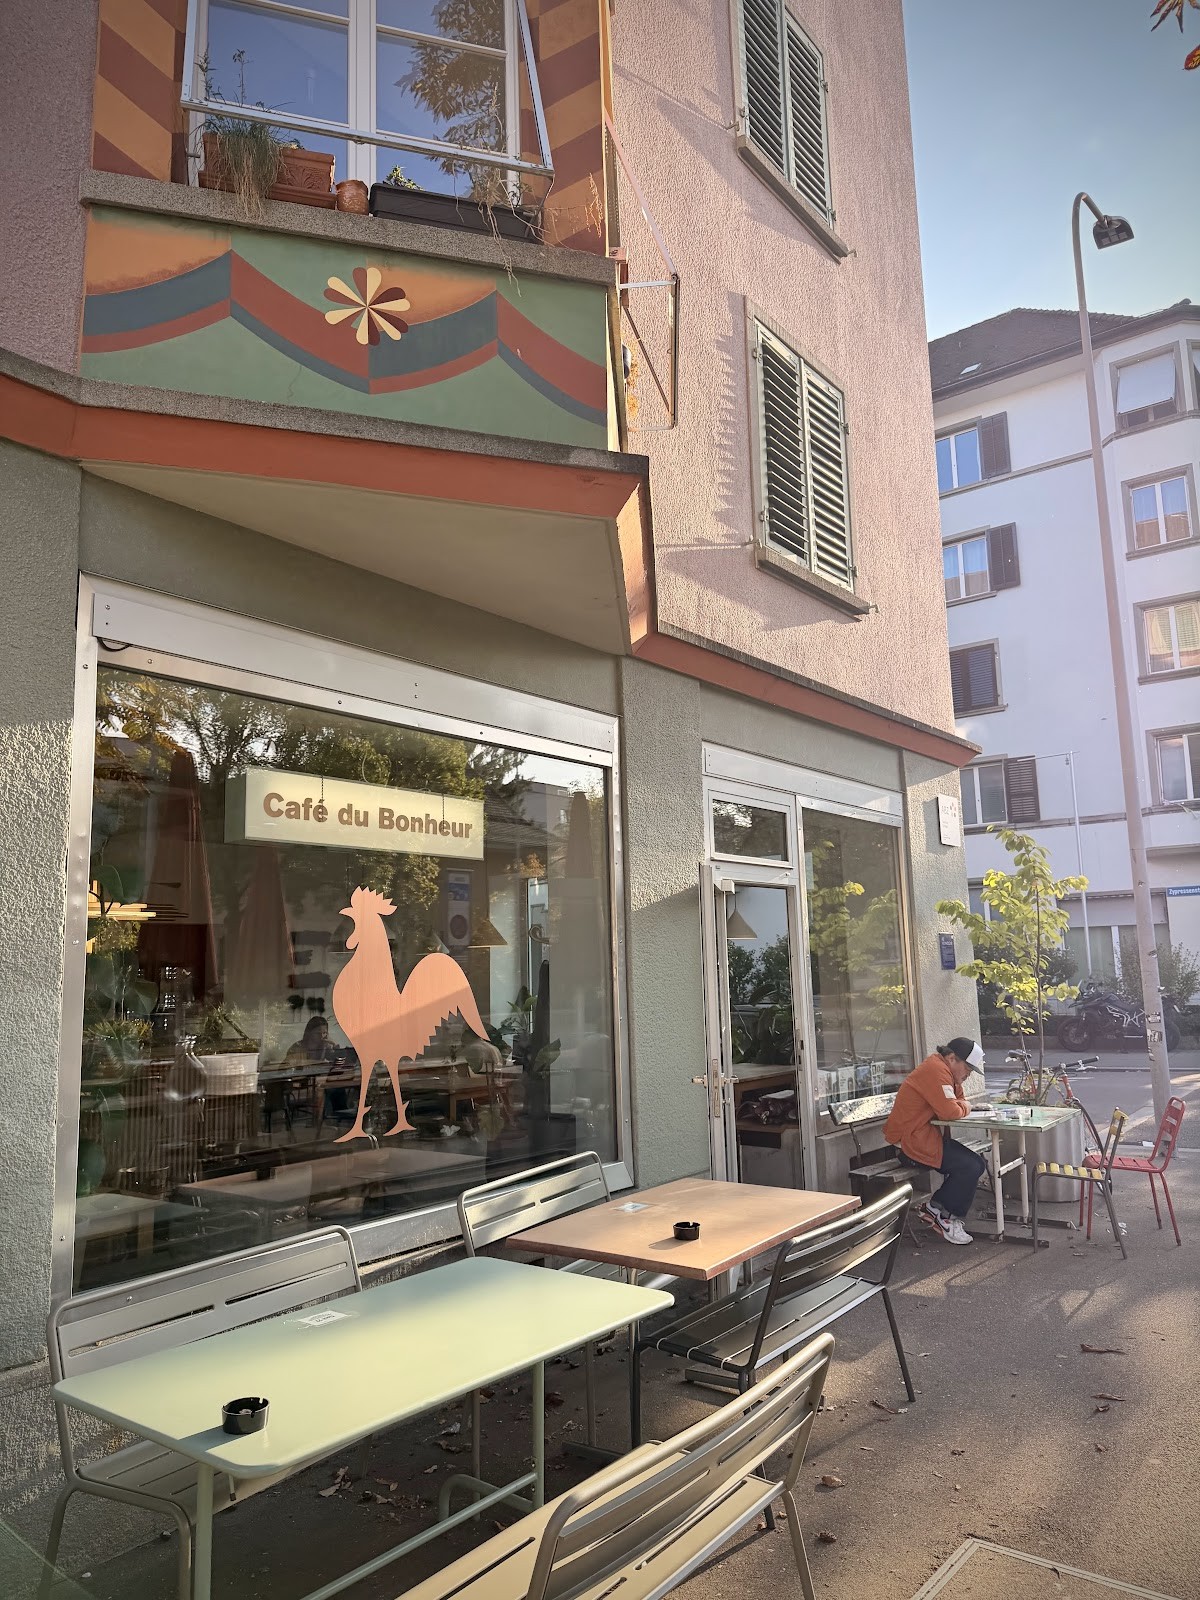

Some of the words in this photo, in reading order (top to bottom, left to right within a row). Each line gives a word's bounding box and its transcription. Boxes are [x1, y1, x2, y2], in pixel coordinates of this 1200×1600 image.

[263, 792, 329, 822] Café
[338, 803, 369, 828] du
[378, 807, 473, 839] Bonheur
